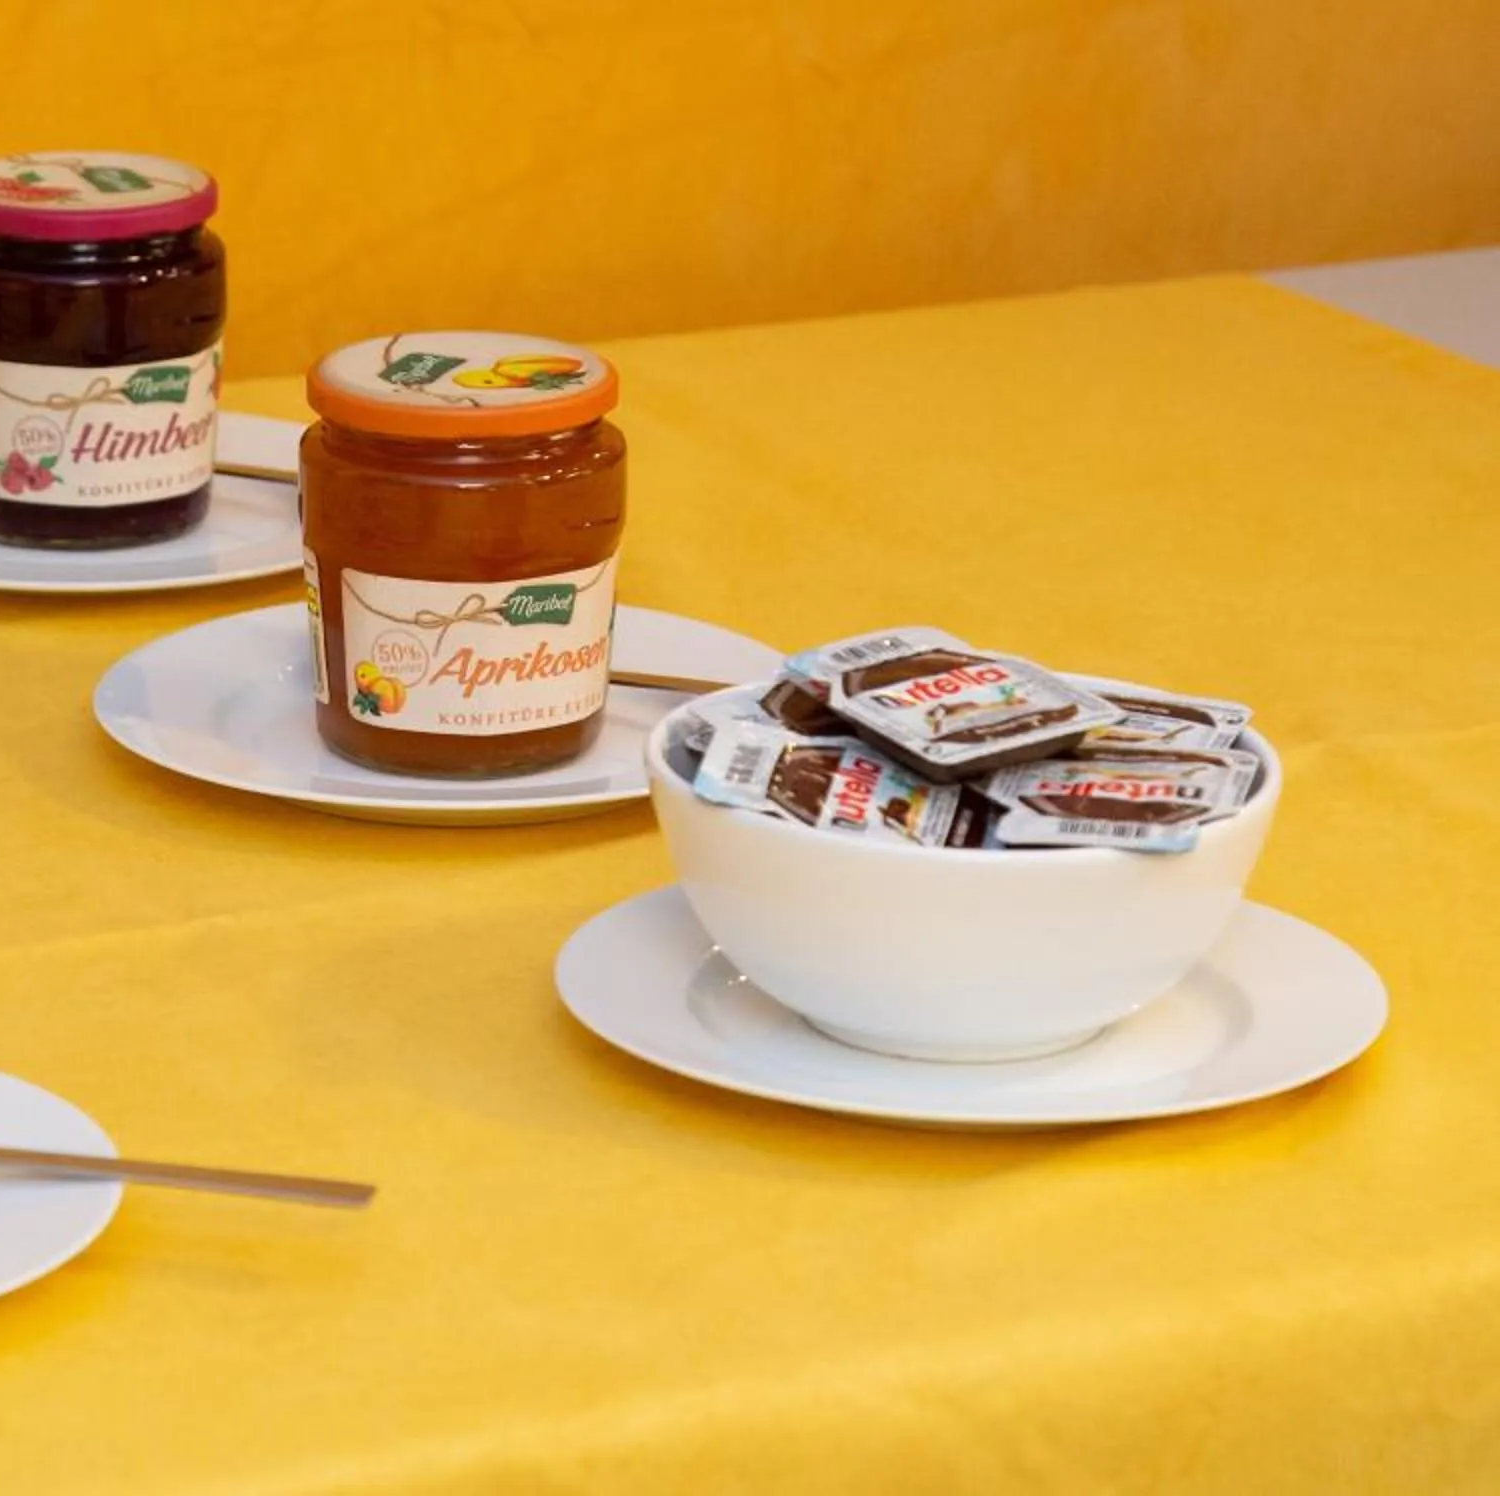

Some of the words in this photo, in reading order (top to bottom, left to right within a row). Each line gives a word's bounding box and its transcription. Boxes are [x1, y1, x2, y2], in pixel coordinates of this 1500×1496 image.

[71, 411, 213, 465] Himbeer
[509, 591, 574, 618] Maribel
[377, 643, 423, 664] 50%
[870, 665, 1010, 709] nutella
[438, 704, 556, 726] KONFITÜRE
[831, 756, 883, 831] nutella
